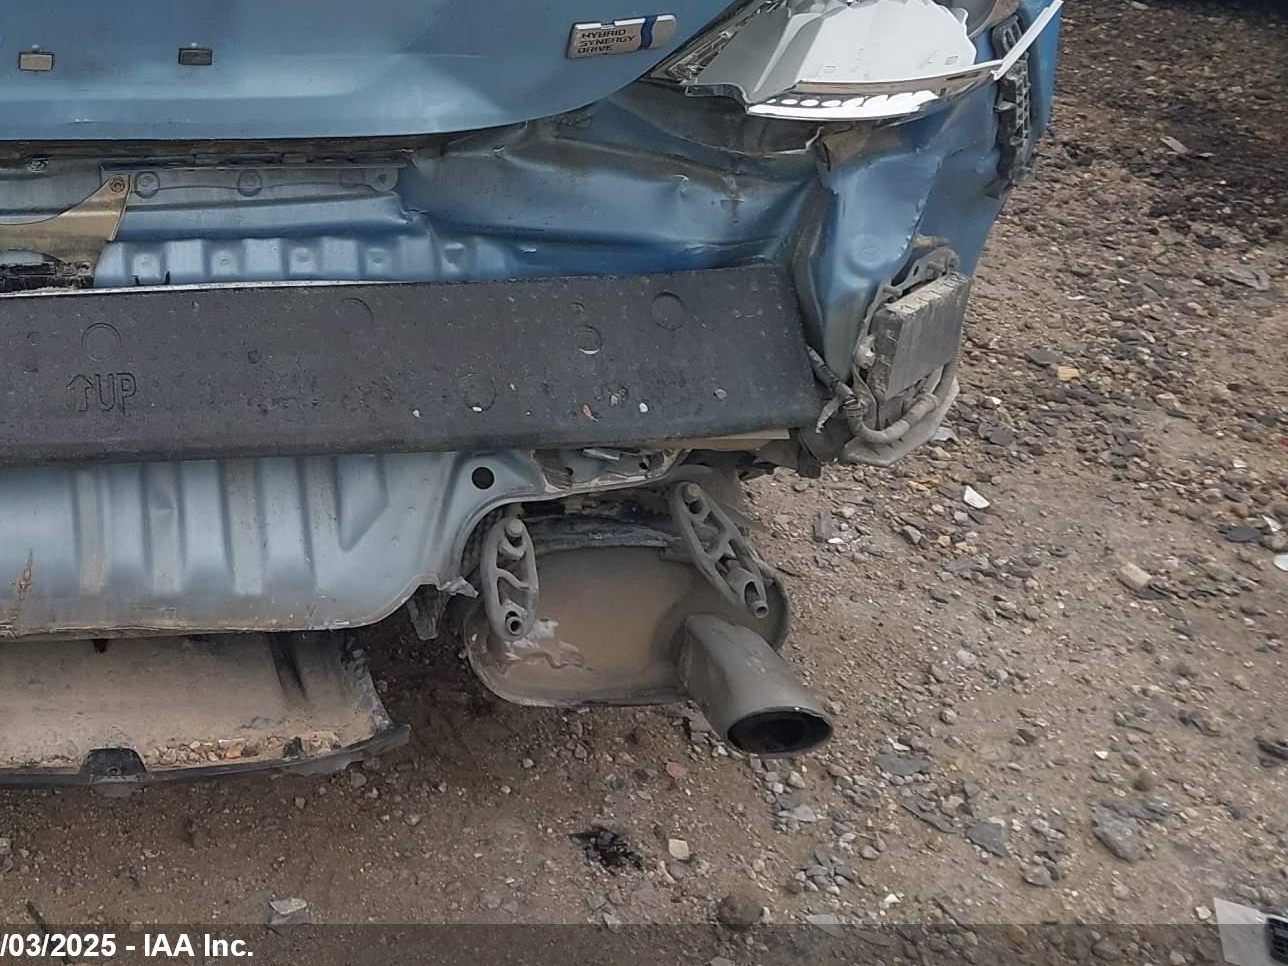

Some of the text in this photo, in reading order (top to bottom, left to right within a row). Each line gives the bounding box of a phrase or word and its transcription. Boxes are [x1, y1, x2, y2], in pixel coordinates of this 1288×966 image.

[582, 29, 626, 39] HYBRID
[579, 35, 635, 47] SYNERGY
[577, 44, 613, 54] DRIVE
[95, 372, 137, 415] UP
